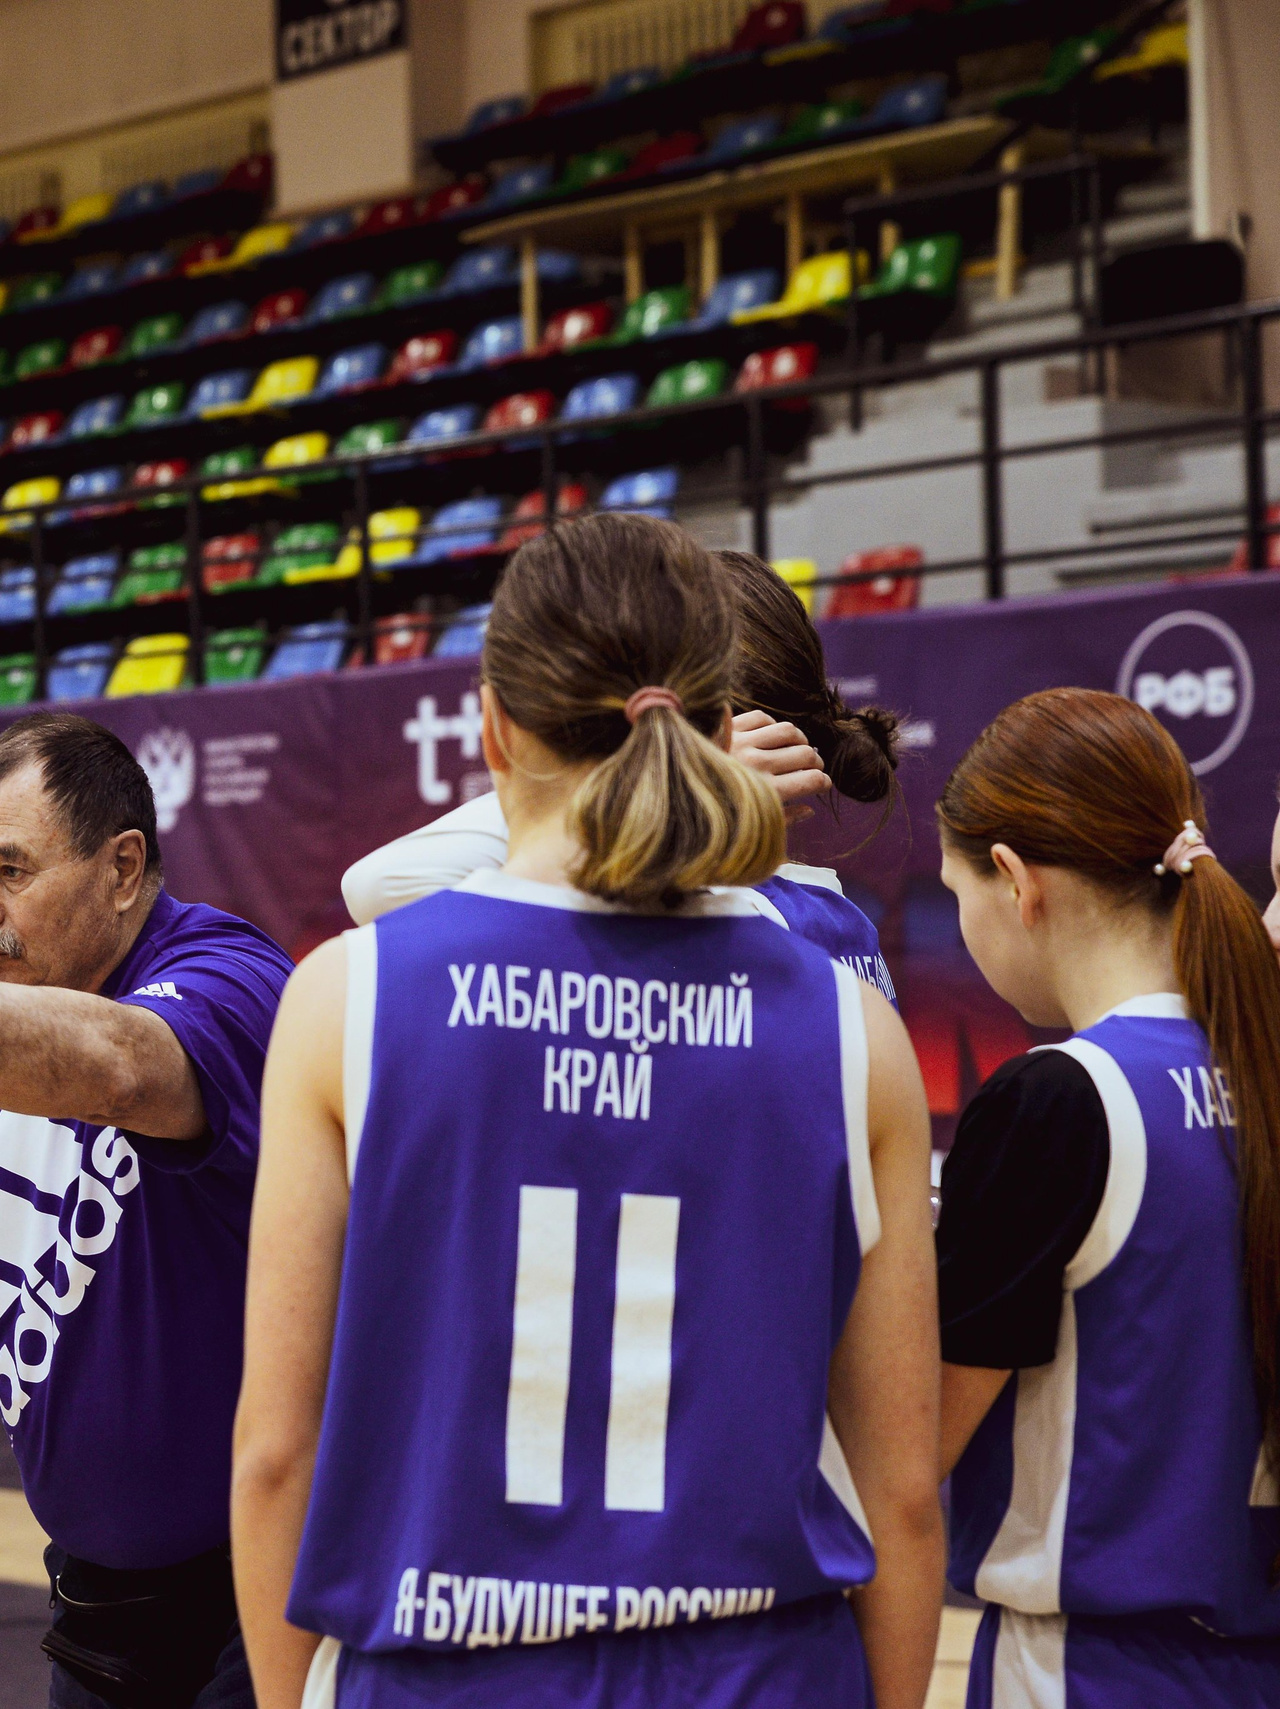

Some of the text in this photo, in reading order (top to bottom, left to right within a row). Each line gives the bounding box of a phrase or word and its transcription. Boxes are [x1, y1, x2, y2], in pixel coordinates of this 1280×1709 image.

[1136, 666, 1235, 718] РФБ
[447, 963, 753, 1048] ХАБАРОВСКИЙ
[544, 1038, 653, 1120] КРАЙ
[505, 1185, 680, 1512] 11
